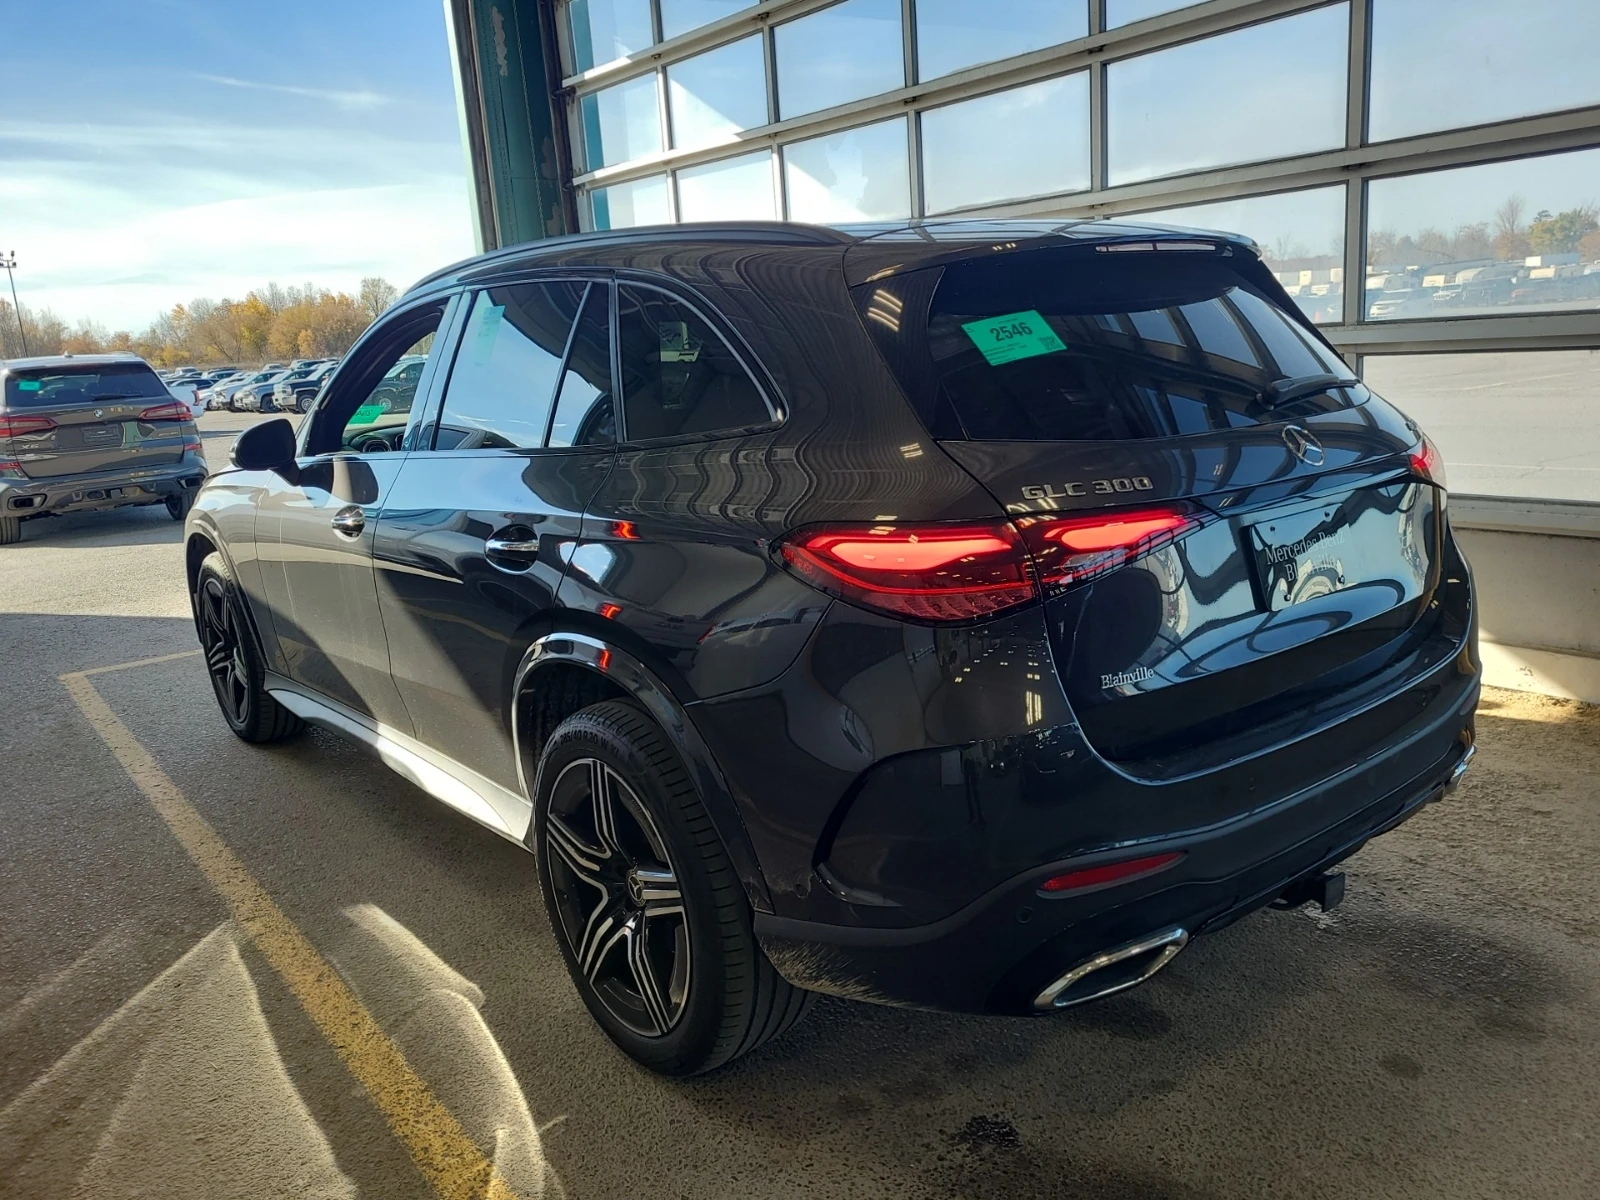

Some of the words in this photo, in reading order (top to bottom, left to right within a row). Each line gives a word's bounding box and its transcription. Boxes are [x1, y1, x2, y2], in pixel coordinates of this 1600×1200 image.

[989, 321, 1033, 342] 2546
[1021, 482, 1087, 500] GLC
[1092, 476, 1154, 494] 300
[1100, 666, 1155, 690] Blainville
